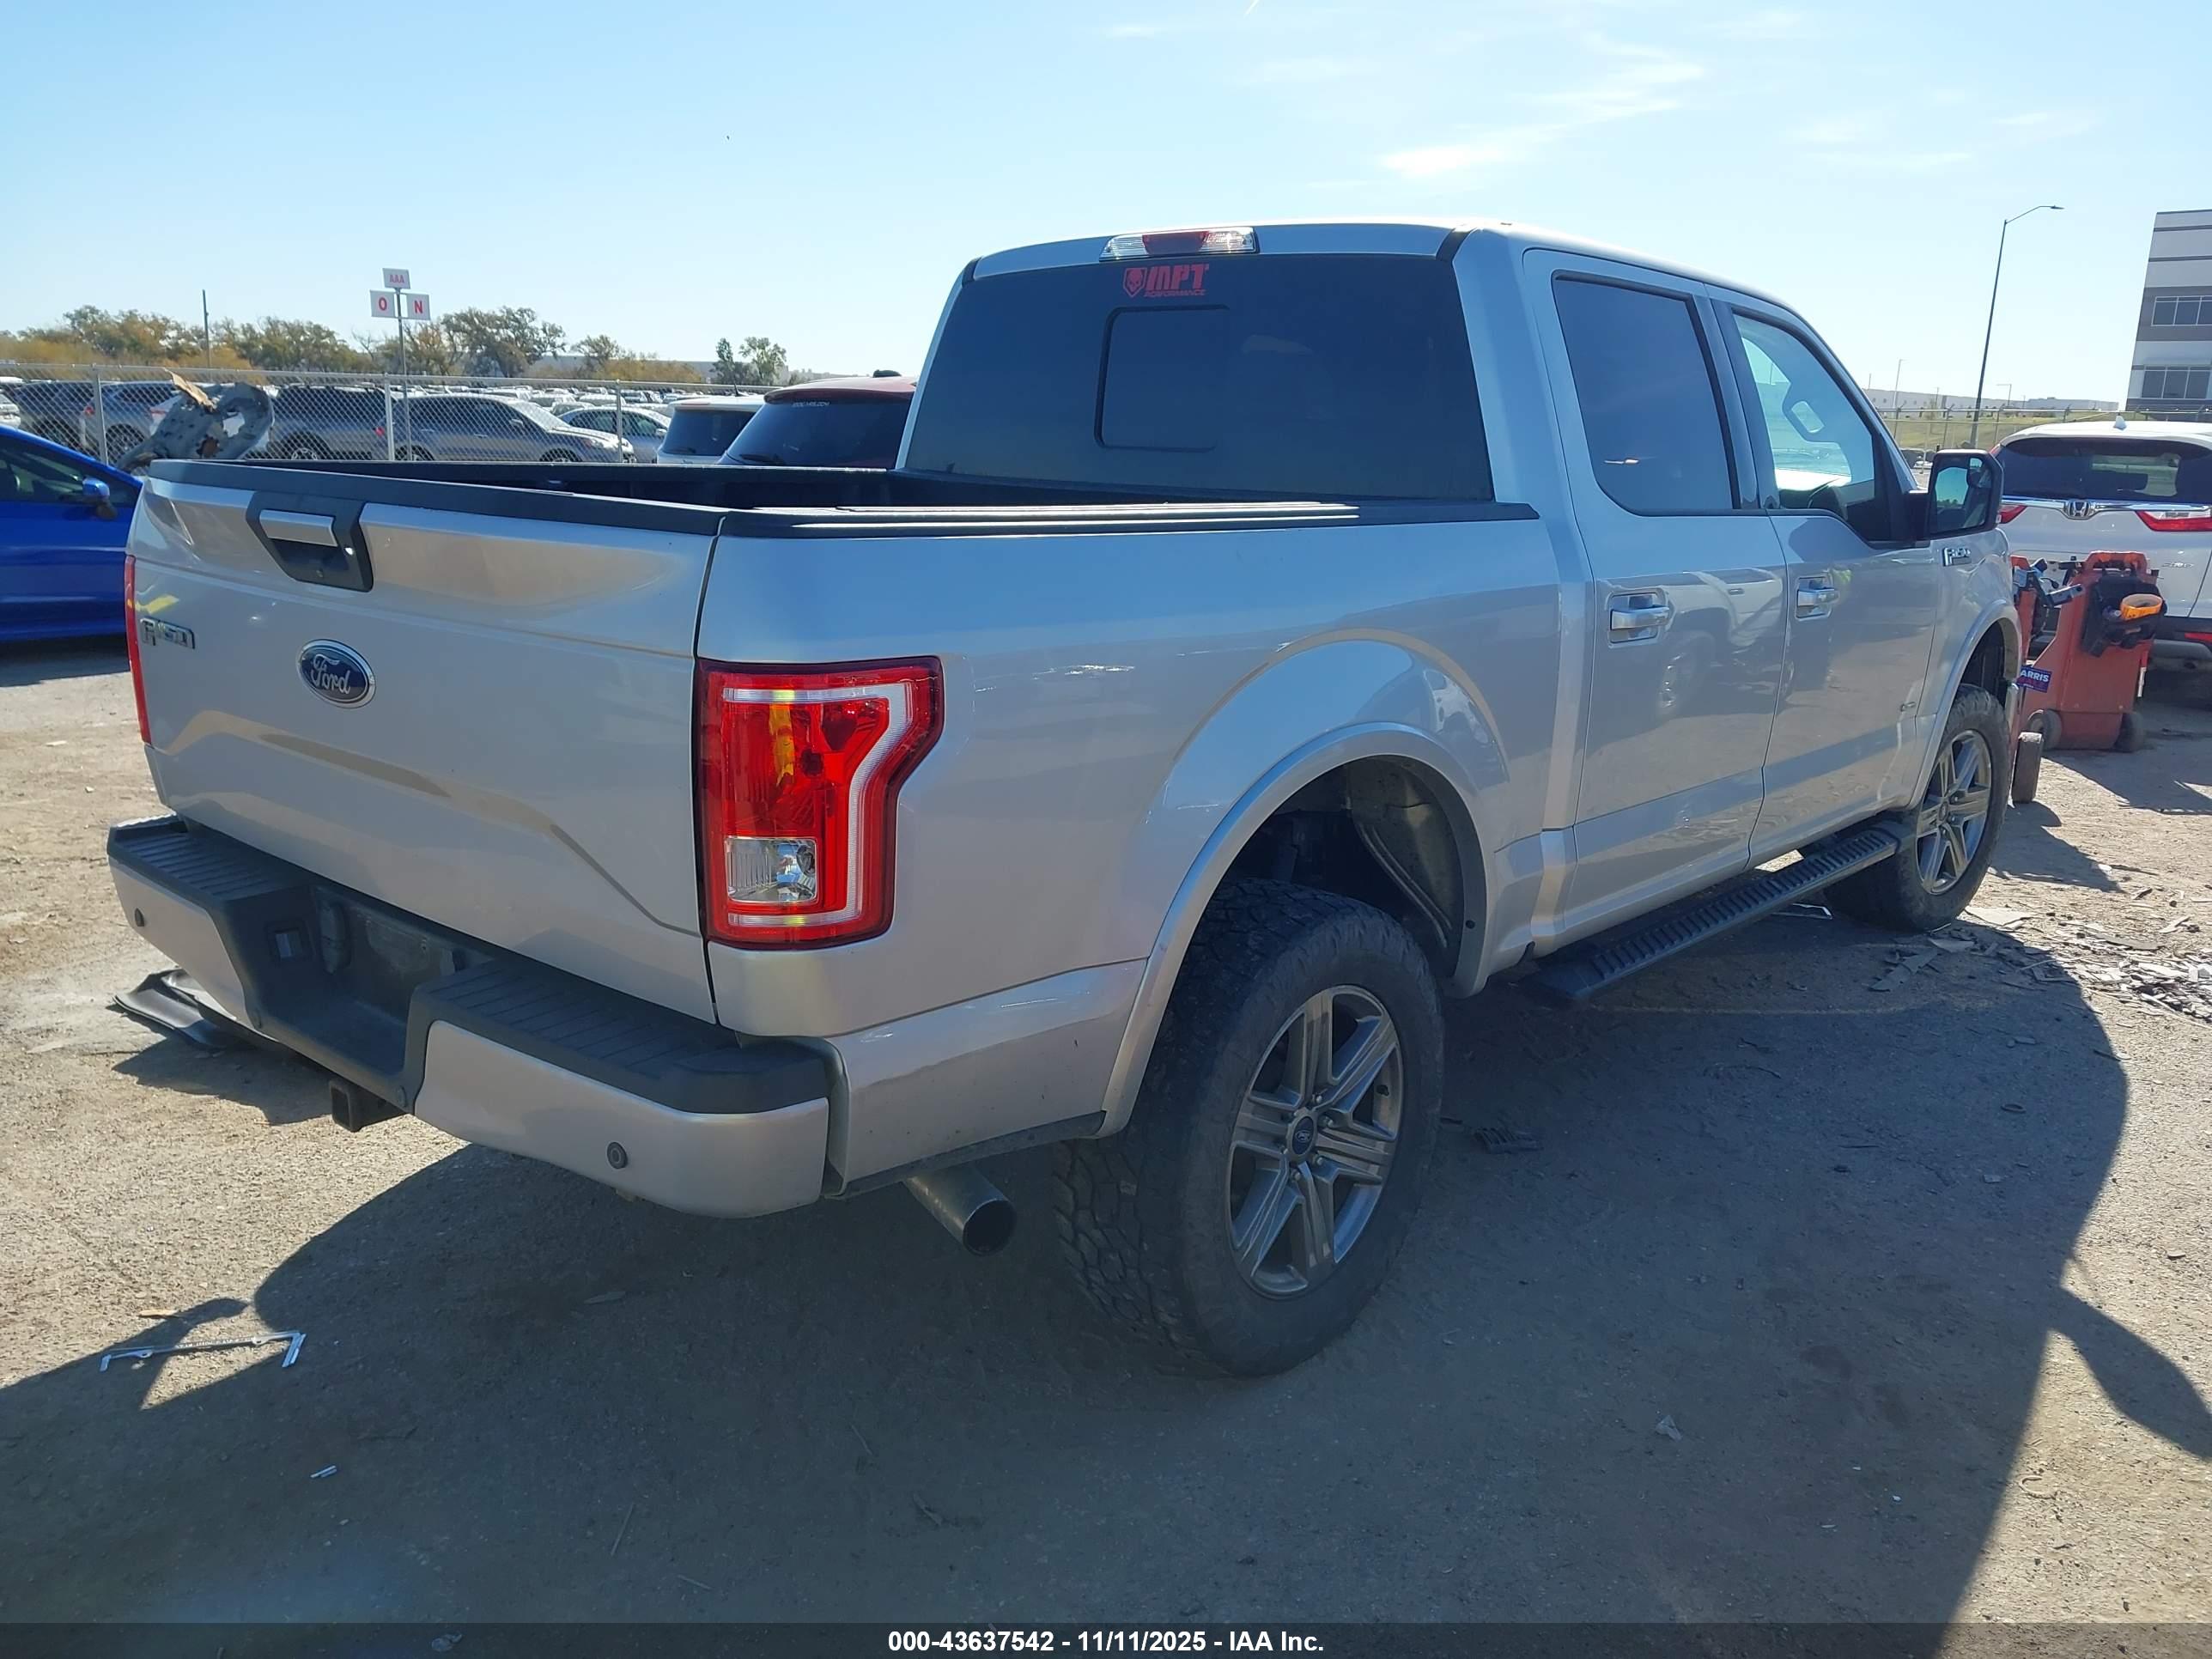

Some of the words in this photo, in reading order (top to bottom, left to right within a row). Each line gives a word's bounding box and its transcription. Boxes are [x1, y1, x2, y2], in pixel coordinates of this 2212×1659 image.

[1146, 264, 1209, 290] MPT
[378, 296, 388, 312] O
[414, 300, 423, 314] N
[310, 653, 352, 695] Ford
[2019, 670, 2050, 683] ARRIS
